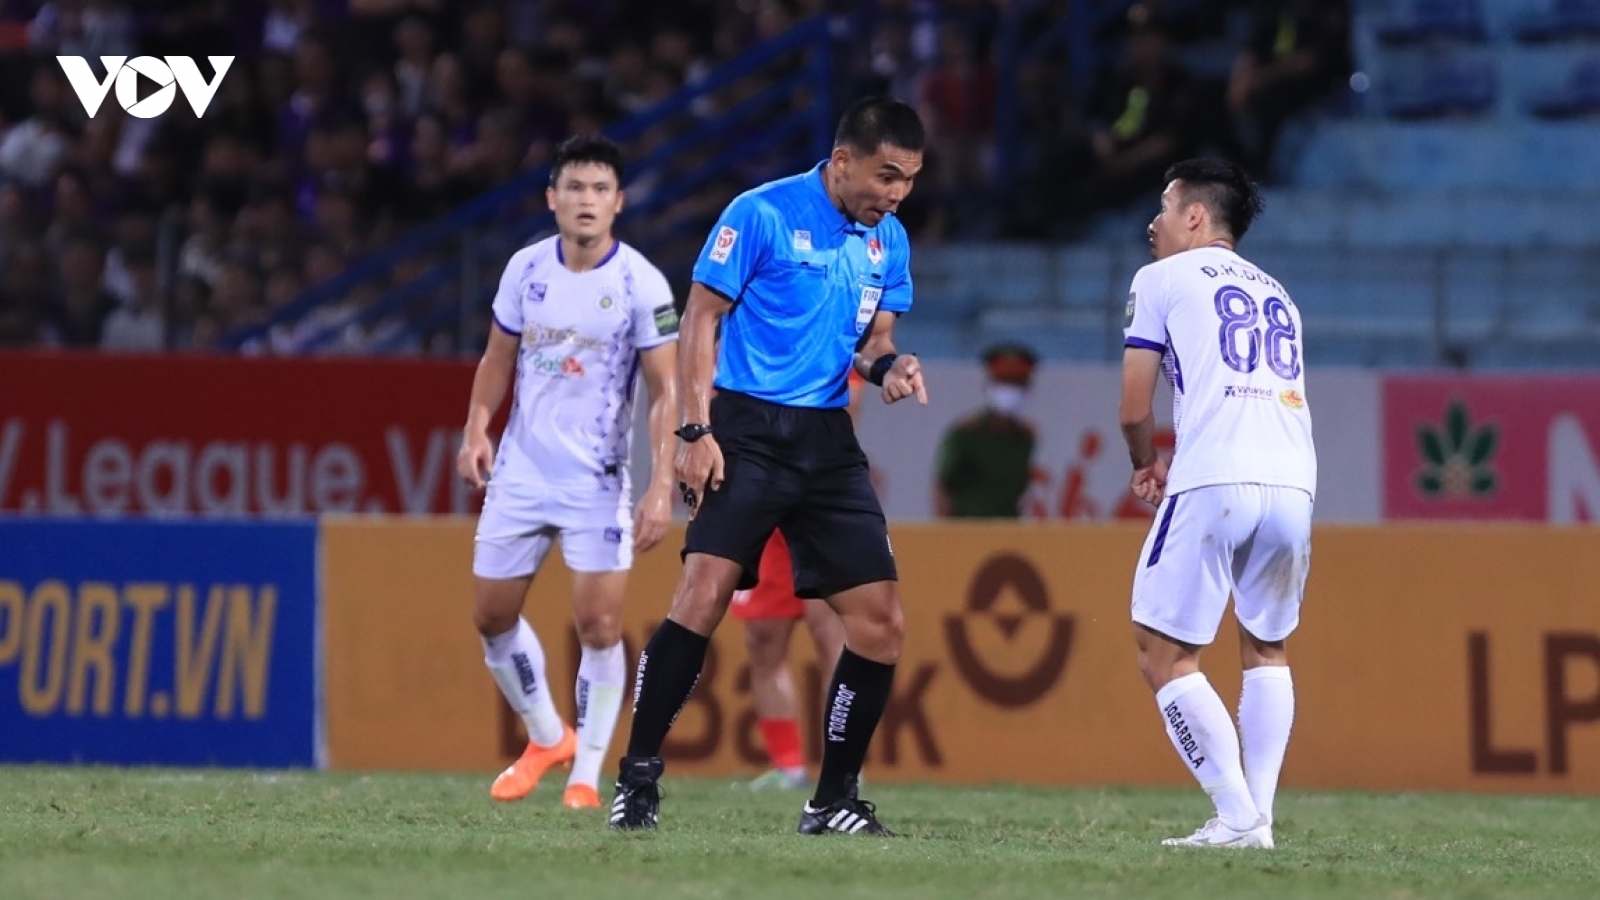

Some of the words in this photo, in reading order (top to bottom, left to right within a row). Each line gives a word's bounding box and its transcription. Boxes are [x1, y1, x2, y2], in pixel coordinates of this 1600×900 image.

[1214, 285, 1300, 380] 88
[827, 682, 857, 741] JOGARBOLA
[1163, 699, 1206, 770] JOGARBOLA
